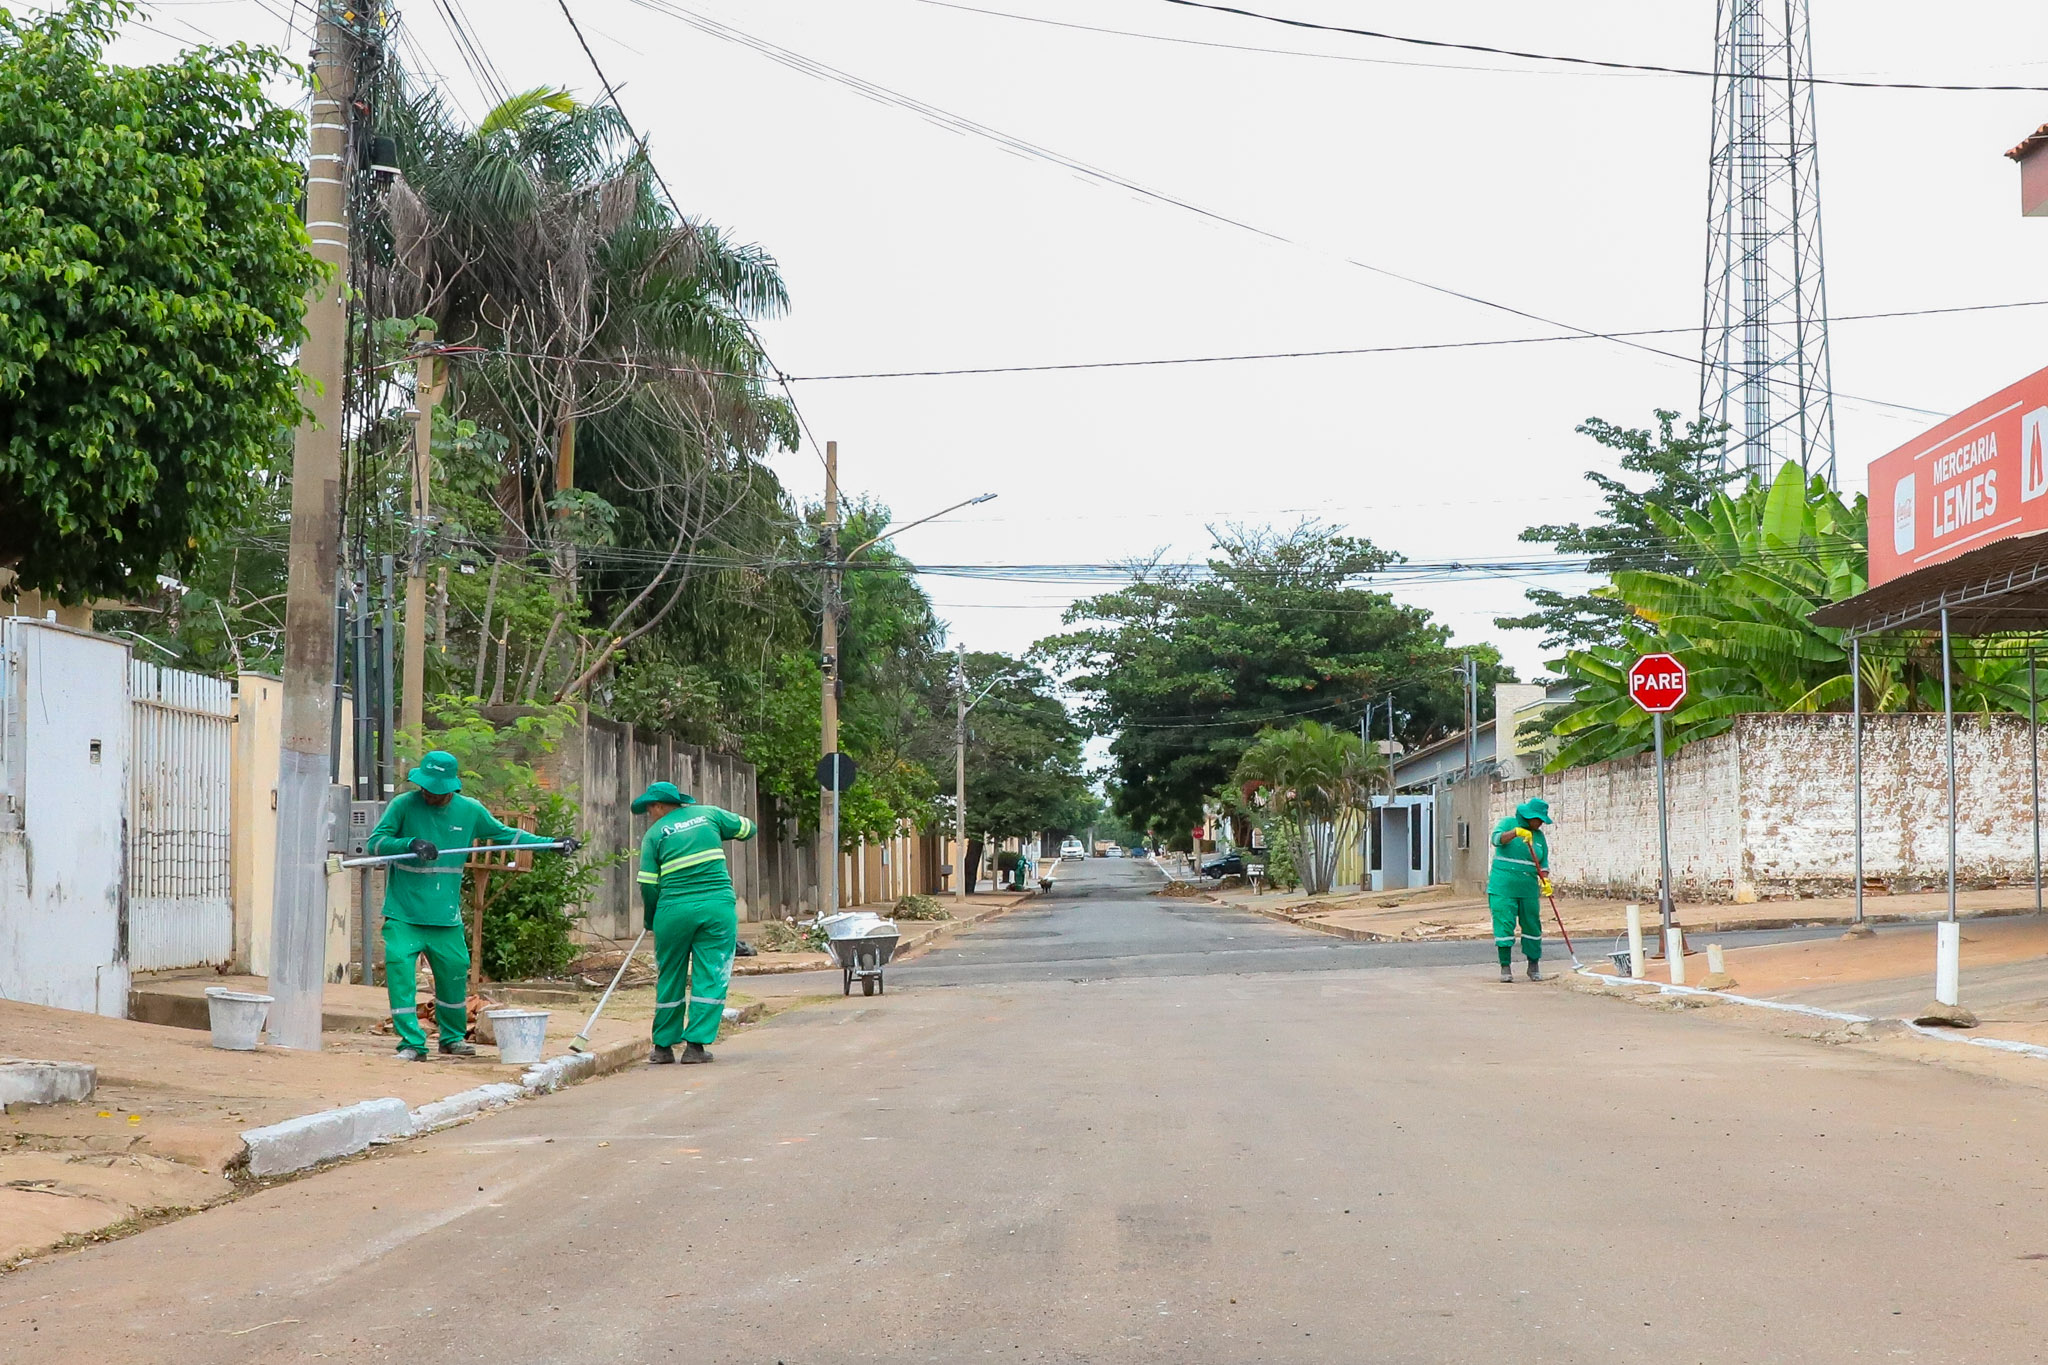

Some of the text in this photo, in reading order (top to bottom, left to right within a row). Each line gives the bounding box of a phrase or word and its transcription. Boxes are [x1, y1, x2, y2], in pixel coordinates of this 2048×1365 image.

[1933, 431, 1998, 486] MERCEARIA
[1933, 468, 1997, 538] LEMES
[1633, 672, 1683, 691] PARE
[674, 815, 707, 830] Ramac
